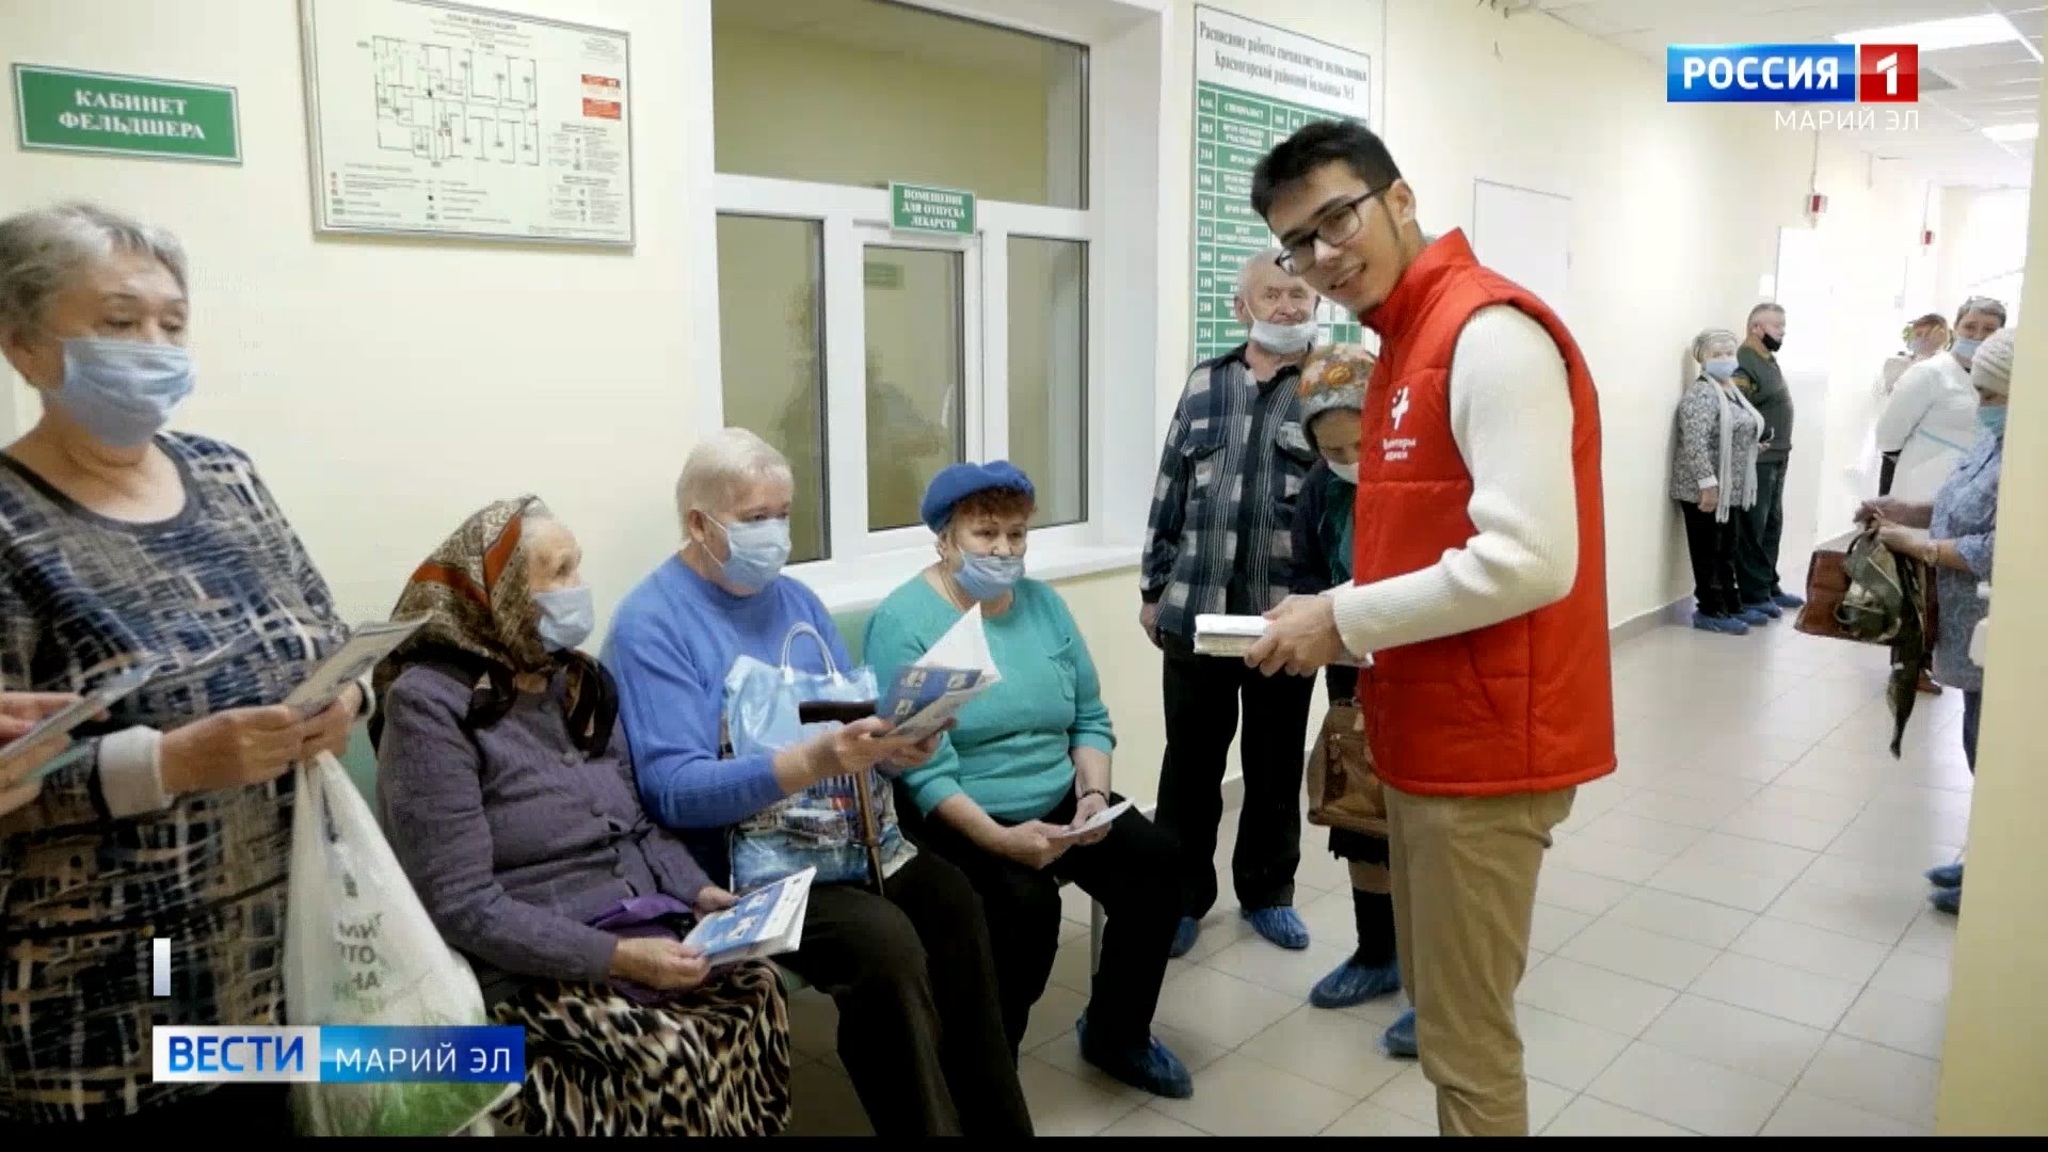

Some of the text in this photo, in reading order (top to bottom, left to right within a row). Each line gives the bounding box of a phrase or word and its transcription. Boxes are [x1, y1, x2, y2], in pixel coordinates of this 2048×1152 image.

[1199, 20, 1246, 48] Расписание
[1247, 36, 1277, 58] работы
[73, 88, 188, 116] КАБИНЕТ
[58, 111, 206, 140] ФЕЛЬДШЕРА
[903, 188, 963, 206] ПОМЕЩЕНИЕ
[901, 200, 966, 219] ДЛЯ ОТПУСКА
[910, 215, 958, 230] ЛЕКАРСТВ
